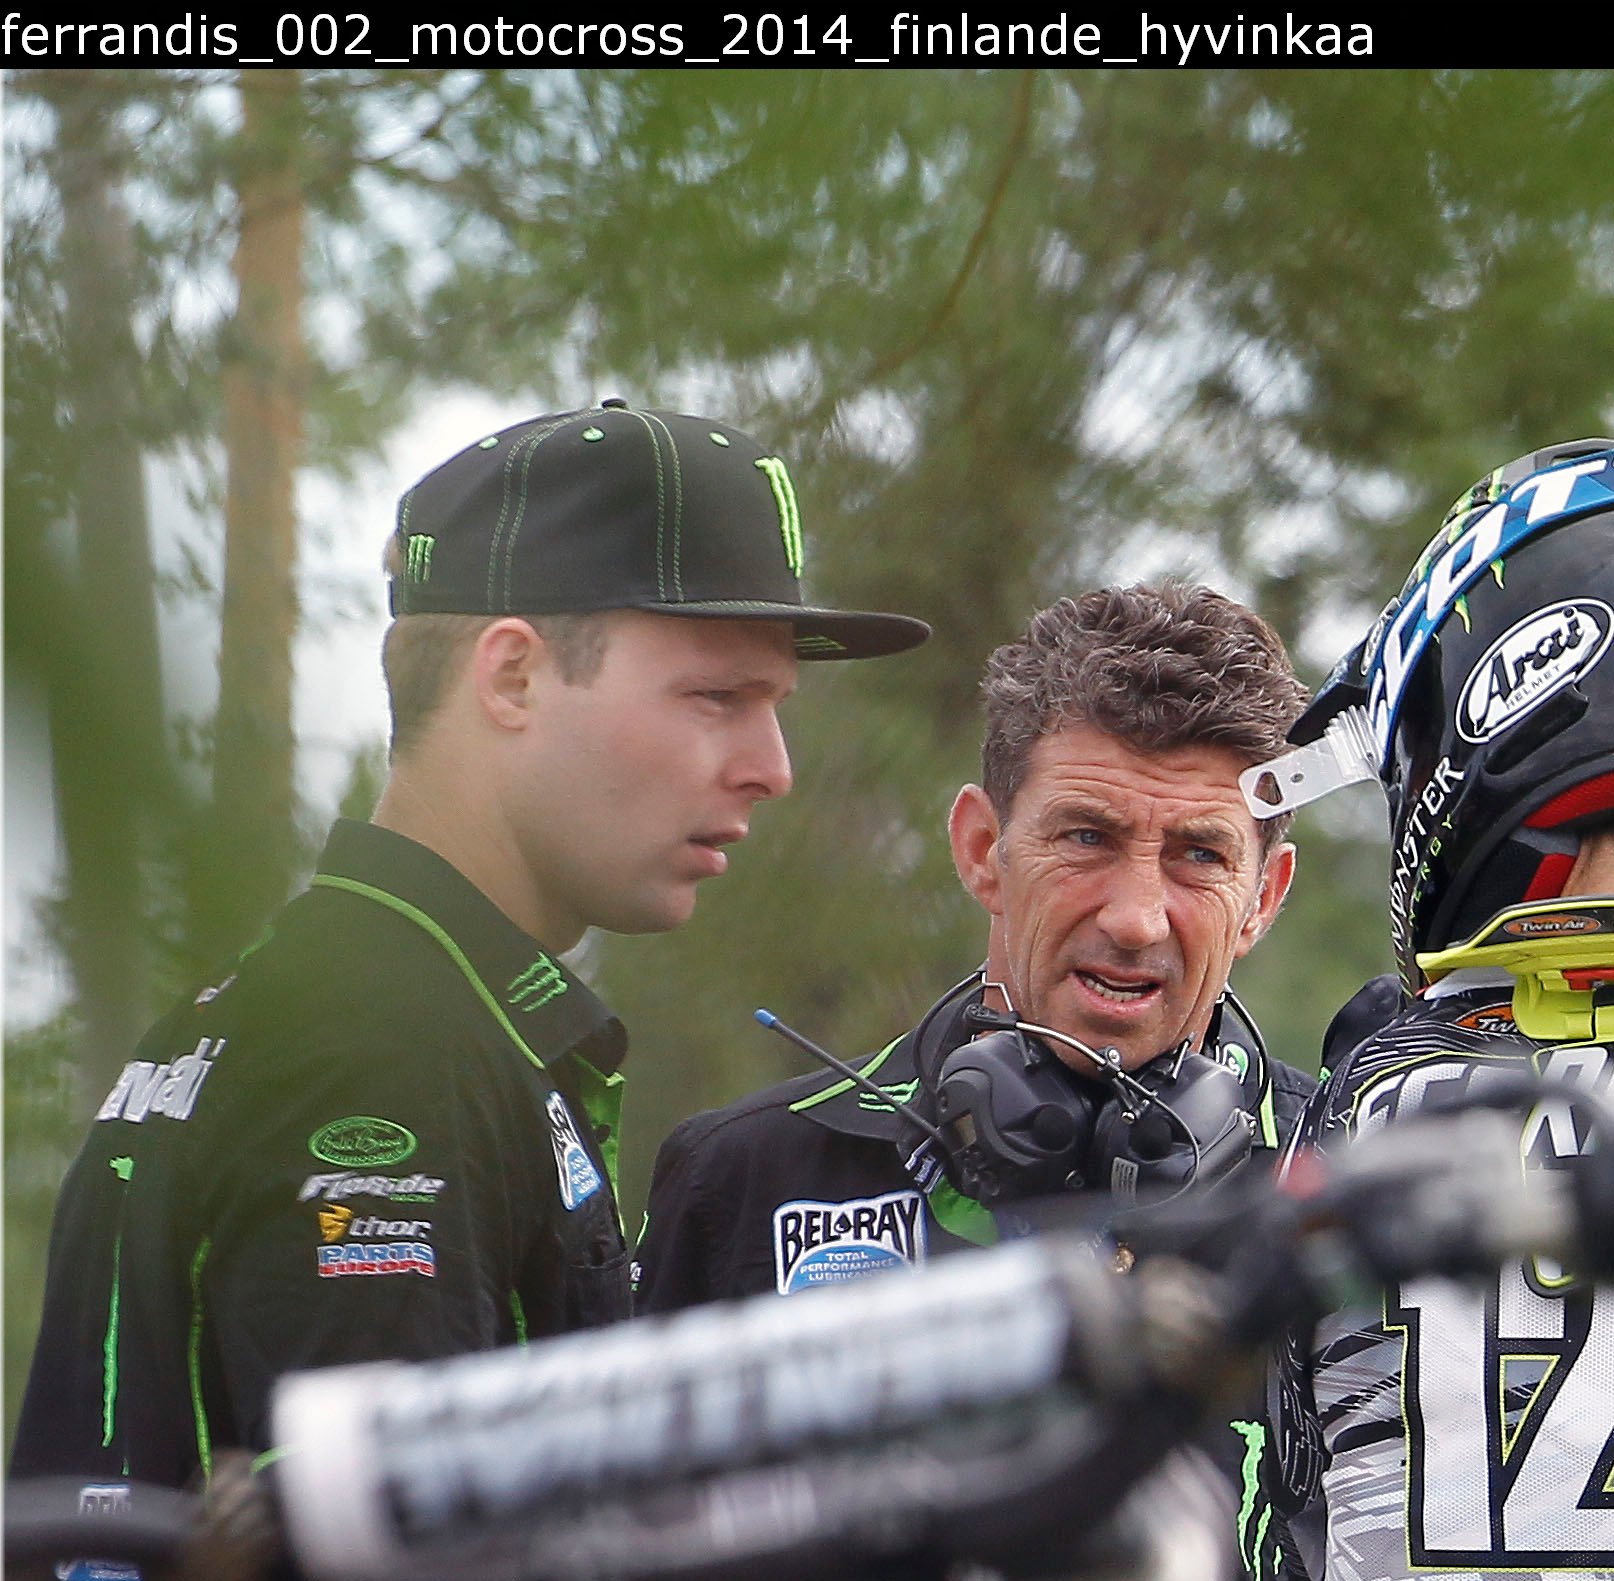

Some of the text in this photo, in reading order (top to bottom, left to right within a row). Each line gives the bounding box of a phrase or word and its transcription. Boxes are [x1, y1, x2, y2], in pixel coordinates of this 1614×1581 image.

[1506, 664, 1561, 711] HELMET
[317, 1242, 434, 1264] PARTS
[826, 1252, 868, 1260] TOTAL
[809, 1271, 875, 1282] LUBRICA
